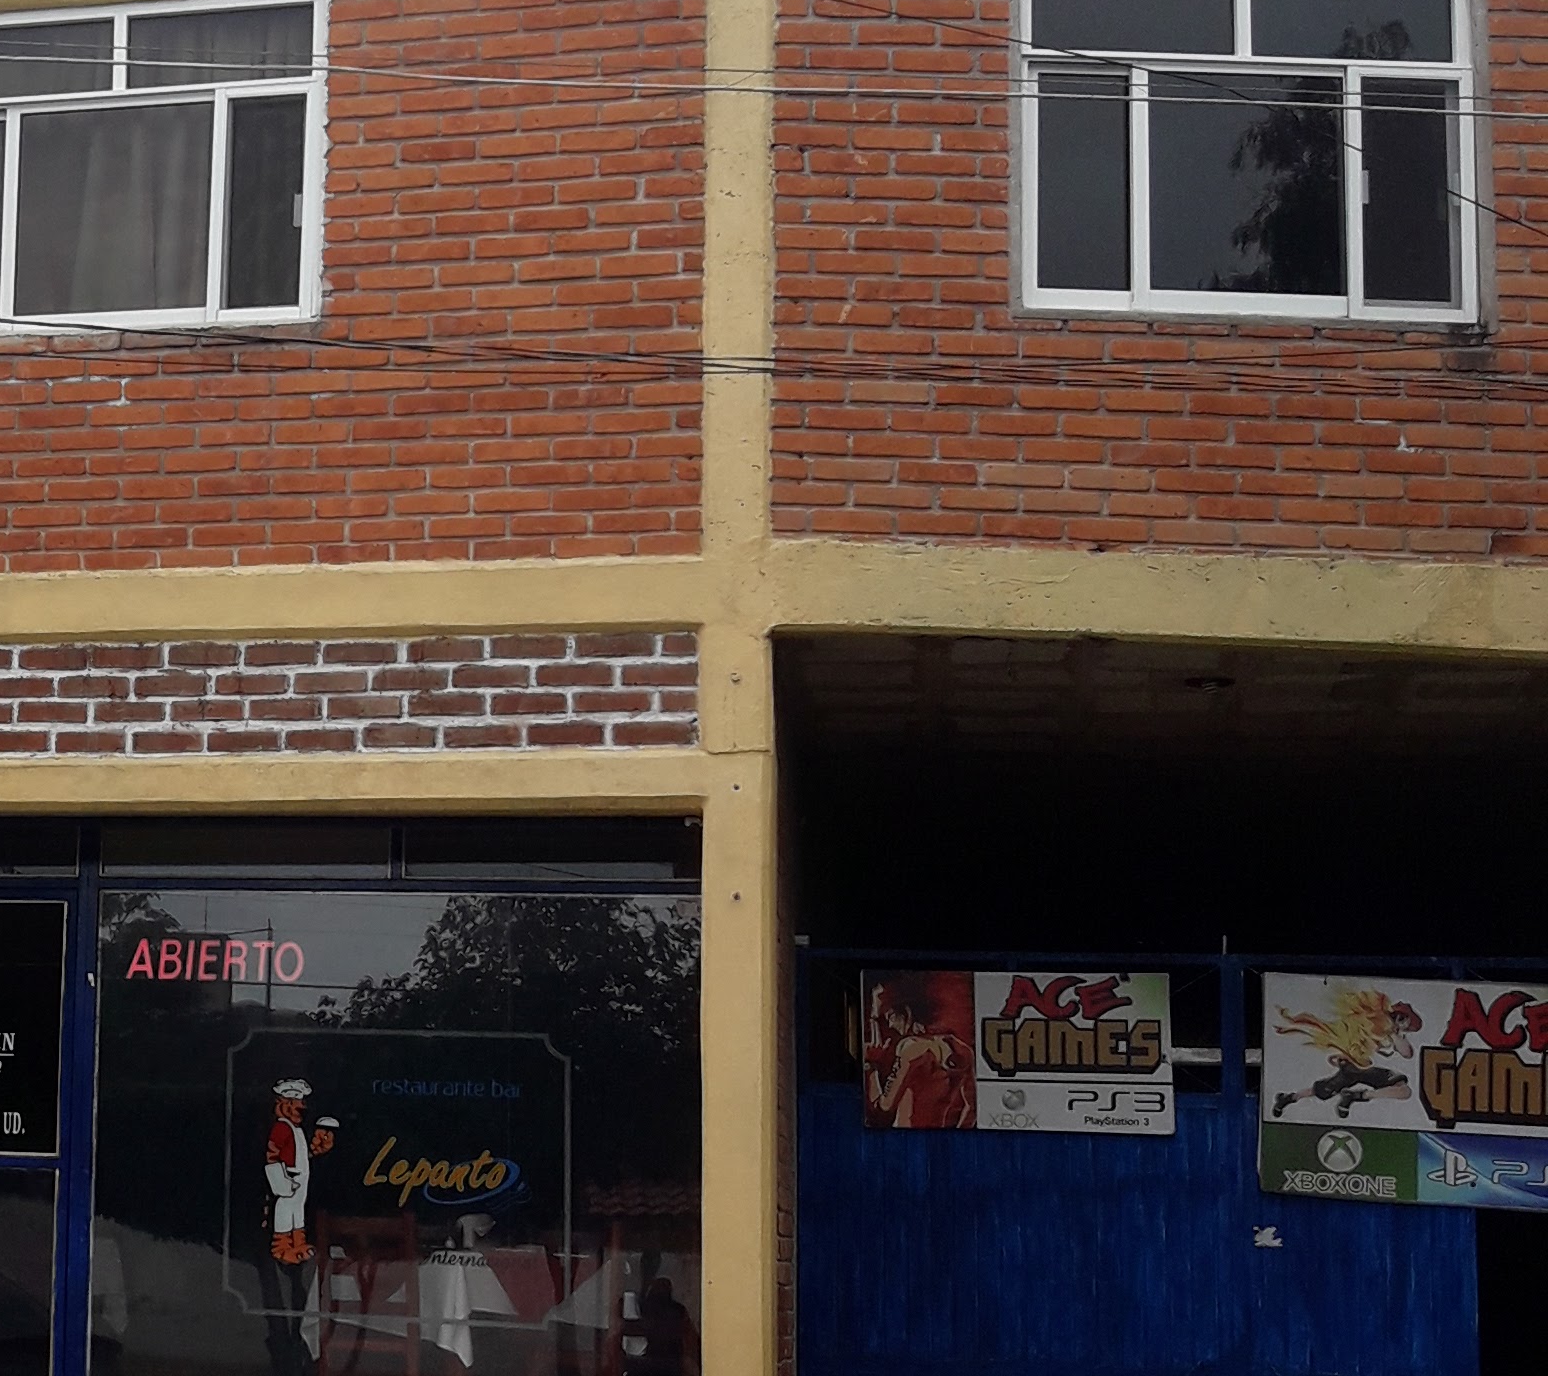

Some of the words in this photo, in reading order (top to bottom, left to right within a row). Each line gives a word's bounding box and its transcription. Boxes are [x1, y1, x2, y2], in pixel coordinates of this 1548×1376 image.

[125, 938, 305, 982] ABIERTO
[999, 975, 1133, 1020] ACE
[982, 1018, 1161, 1077] GAMES
[372, 1079, 485, 1097] restaurante
[490, 1079, 522, 1098] bar
[1067, 1090, 1166, 1113] PS3
[1419, 1046, 1548, 1129] GAM
[3, 1111, 26, 1135] UD.
[988, 1113, 1040, 1129] XBOX
[1084, 1115, 1139, 1128] PlayStation
[1143, 1117, 1150, 1127] 3
[363, 1136, 507, 1208] Lepanto
